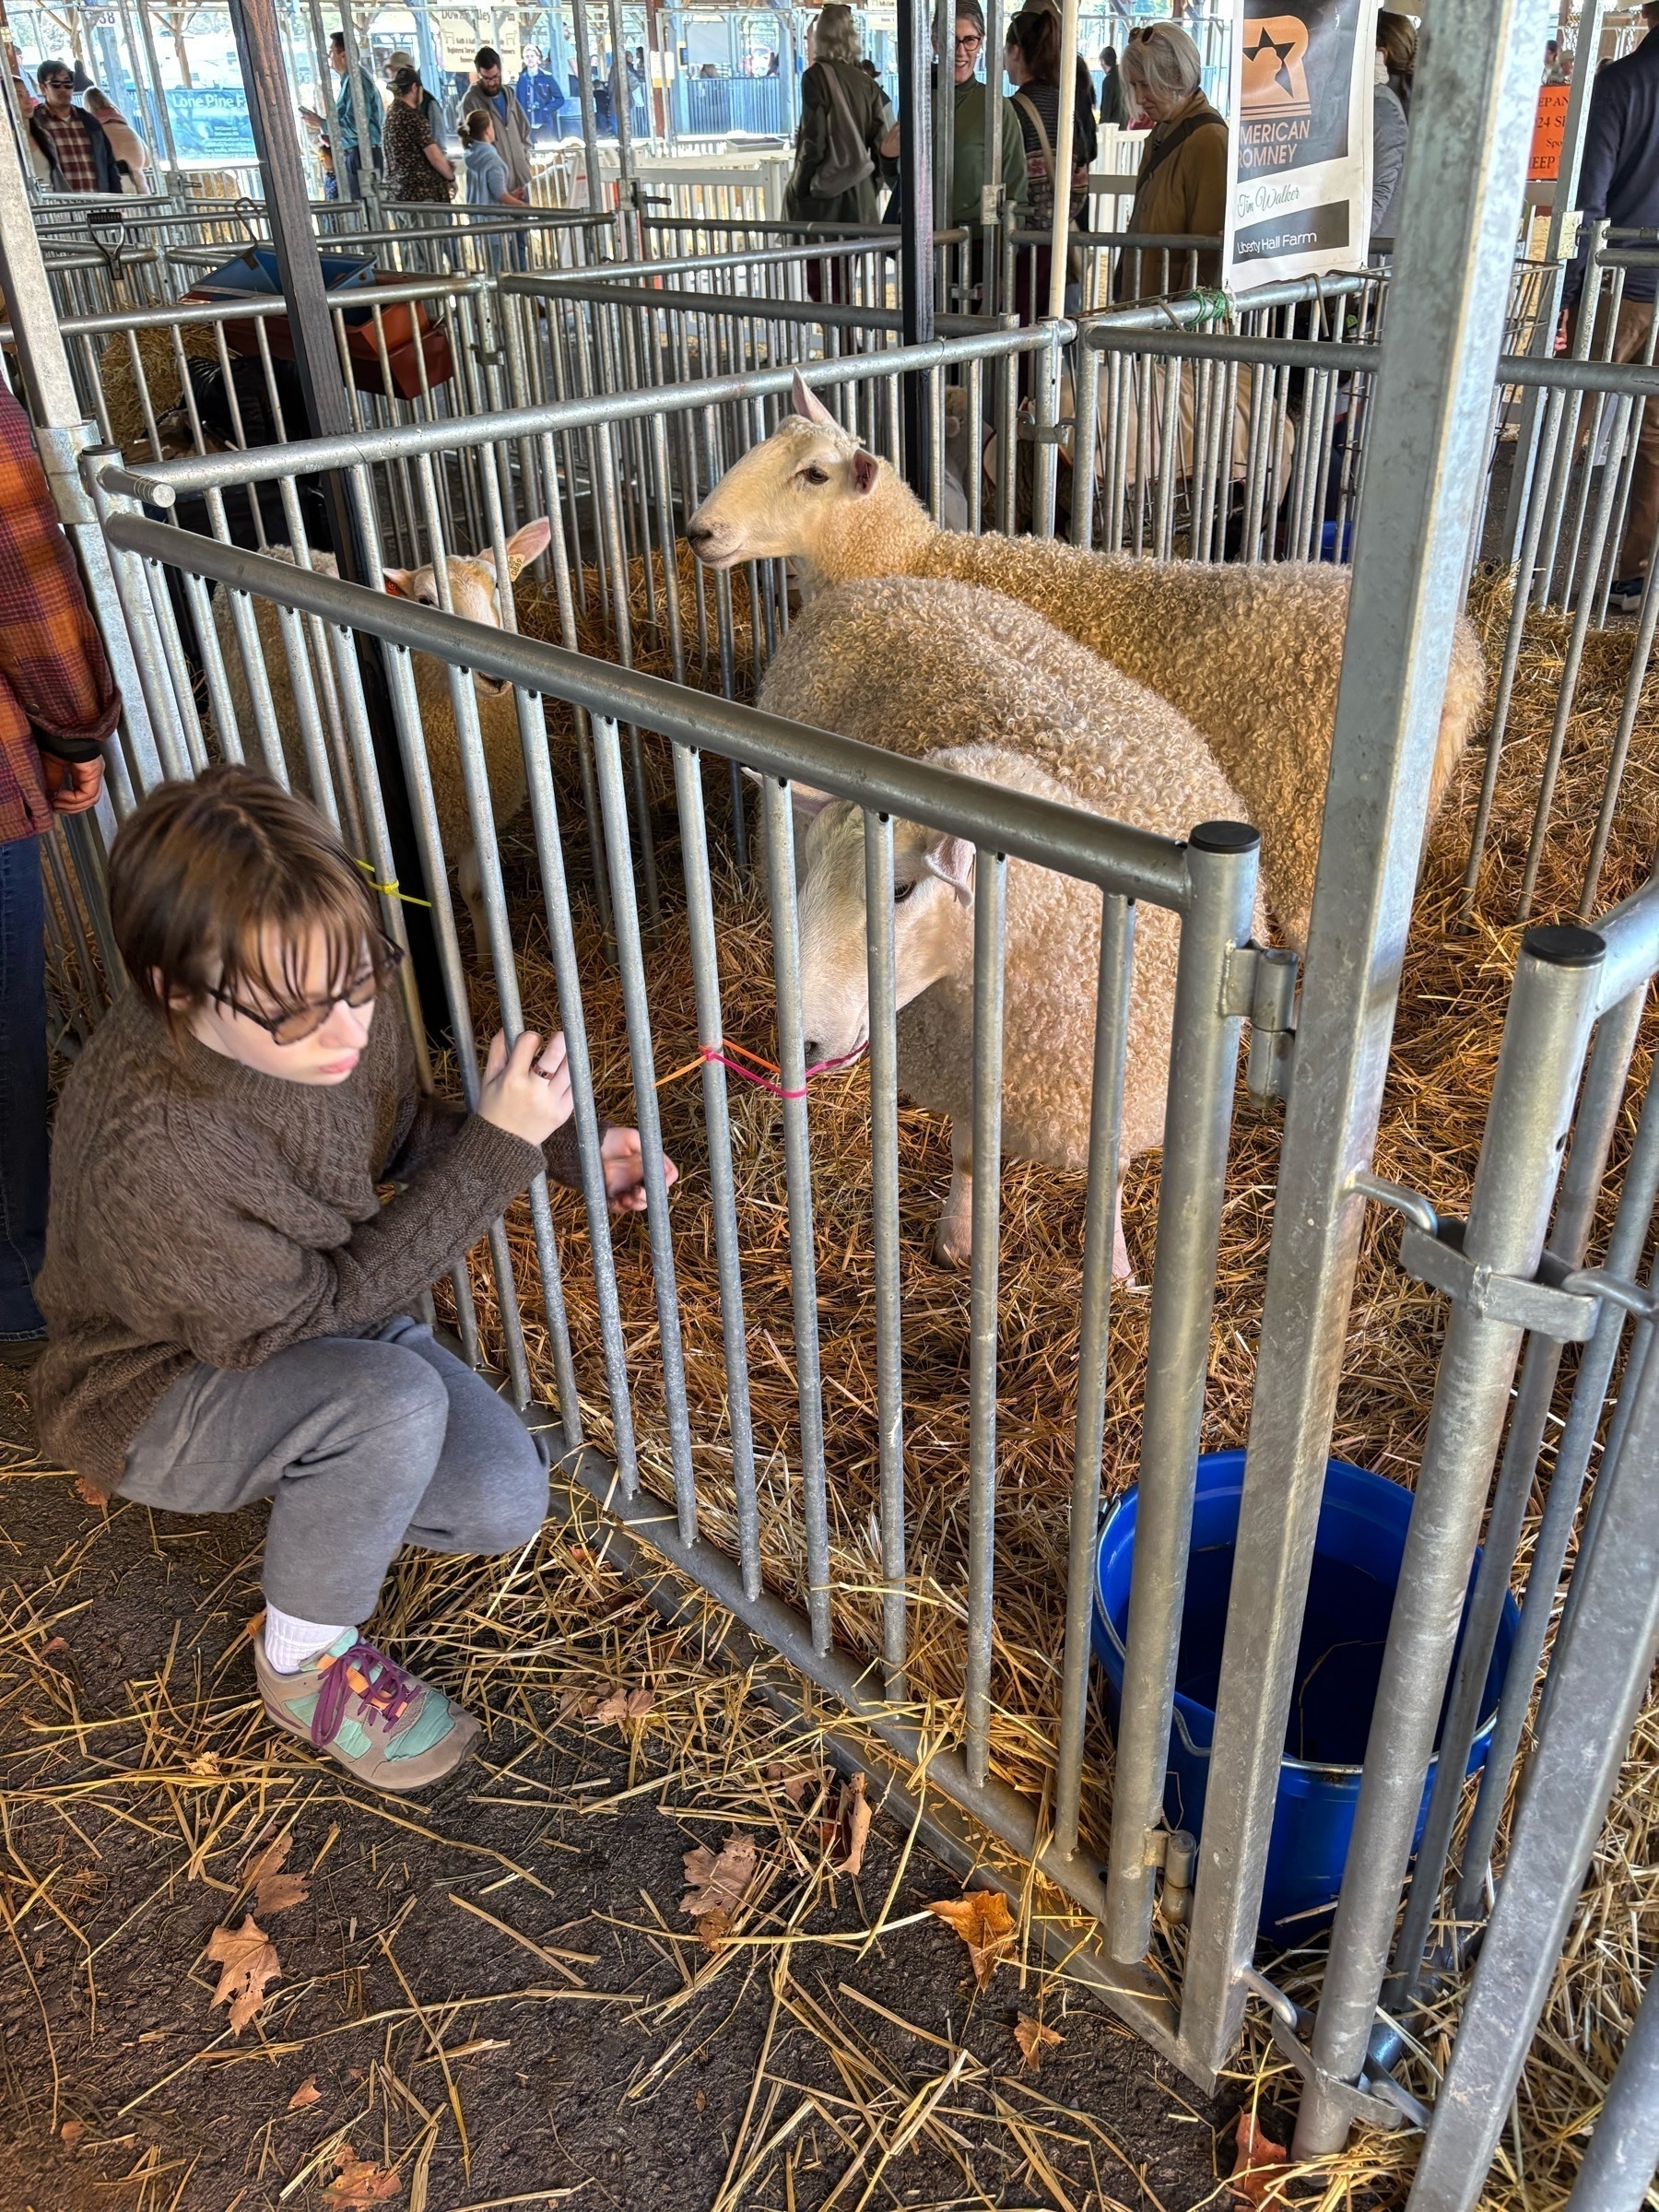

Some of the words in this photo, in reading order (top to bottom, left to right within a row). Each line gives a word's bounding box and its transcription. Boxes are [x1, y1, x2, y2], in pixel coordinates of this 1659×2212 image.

[171, 93, 204, 108] Lone
[205, 93, 234, 108] Pine
[1537, 97, 1552, 107] EP
[1239, 120, 1310, 145] MERICAN
[1546, 138, 1563, 148] Spo
[1528, 156, 1556, 170] EEP
[1237, 194, 1254, 218] Tim
[1255, 183, 1300, 212] Walker
[1237, 240, 1261, 254] Liberty
[1262, 235, 1280, 251] Hall
[1282, 232, 1317, 247] Farm
